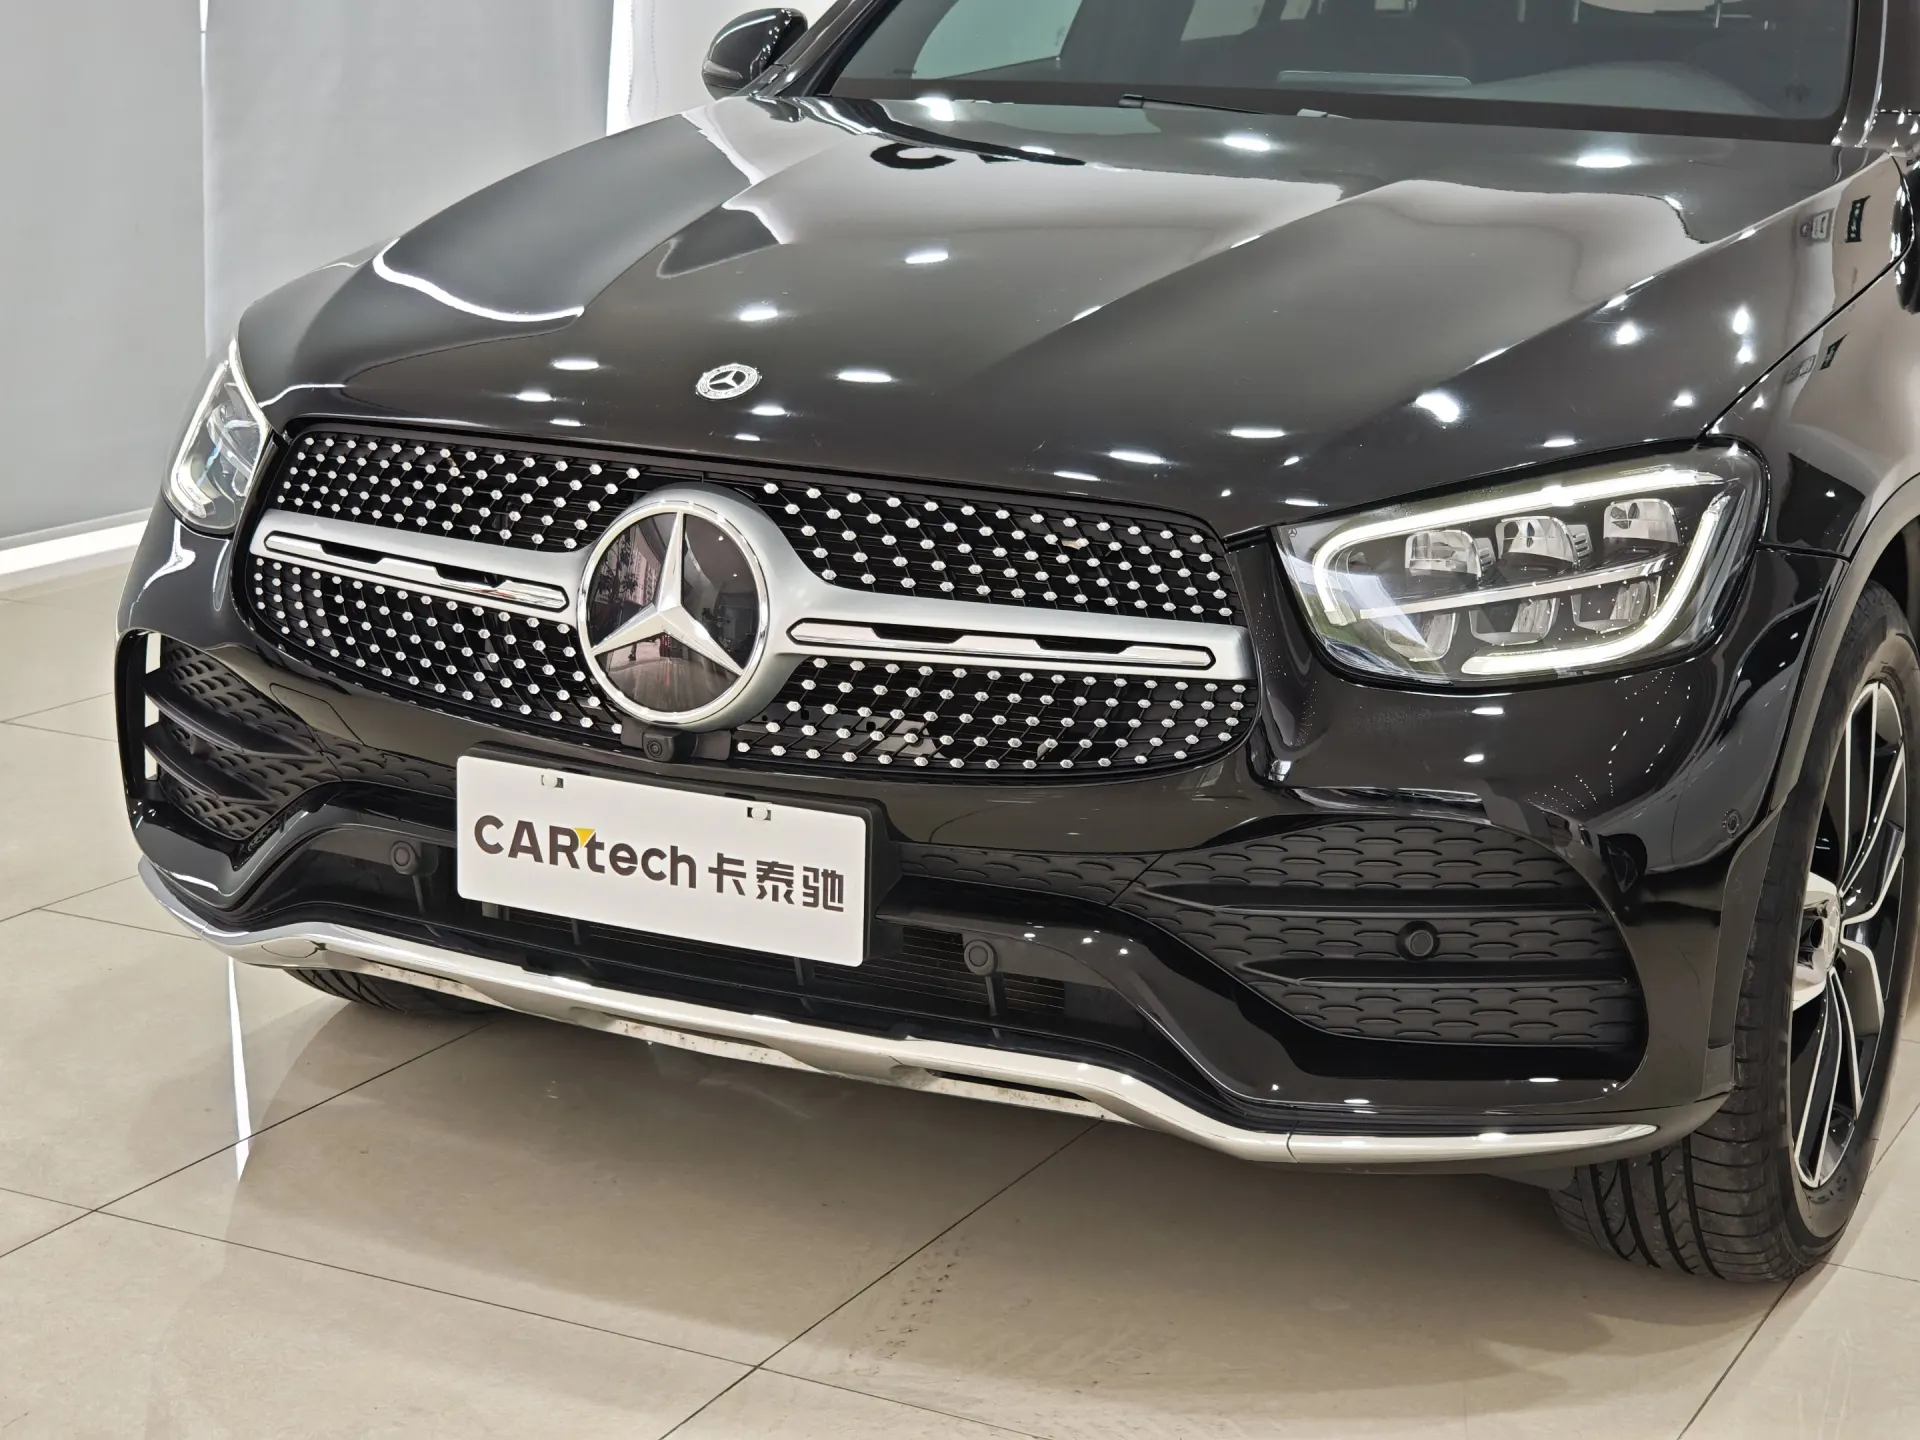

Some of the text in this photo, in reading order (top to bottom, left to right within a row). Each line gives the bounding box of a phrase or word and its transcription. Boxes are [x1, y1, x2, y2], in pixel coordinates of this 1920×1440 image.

[474, 814, 844, 912] CARtech 卡泰驰
